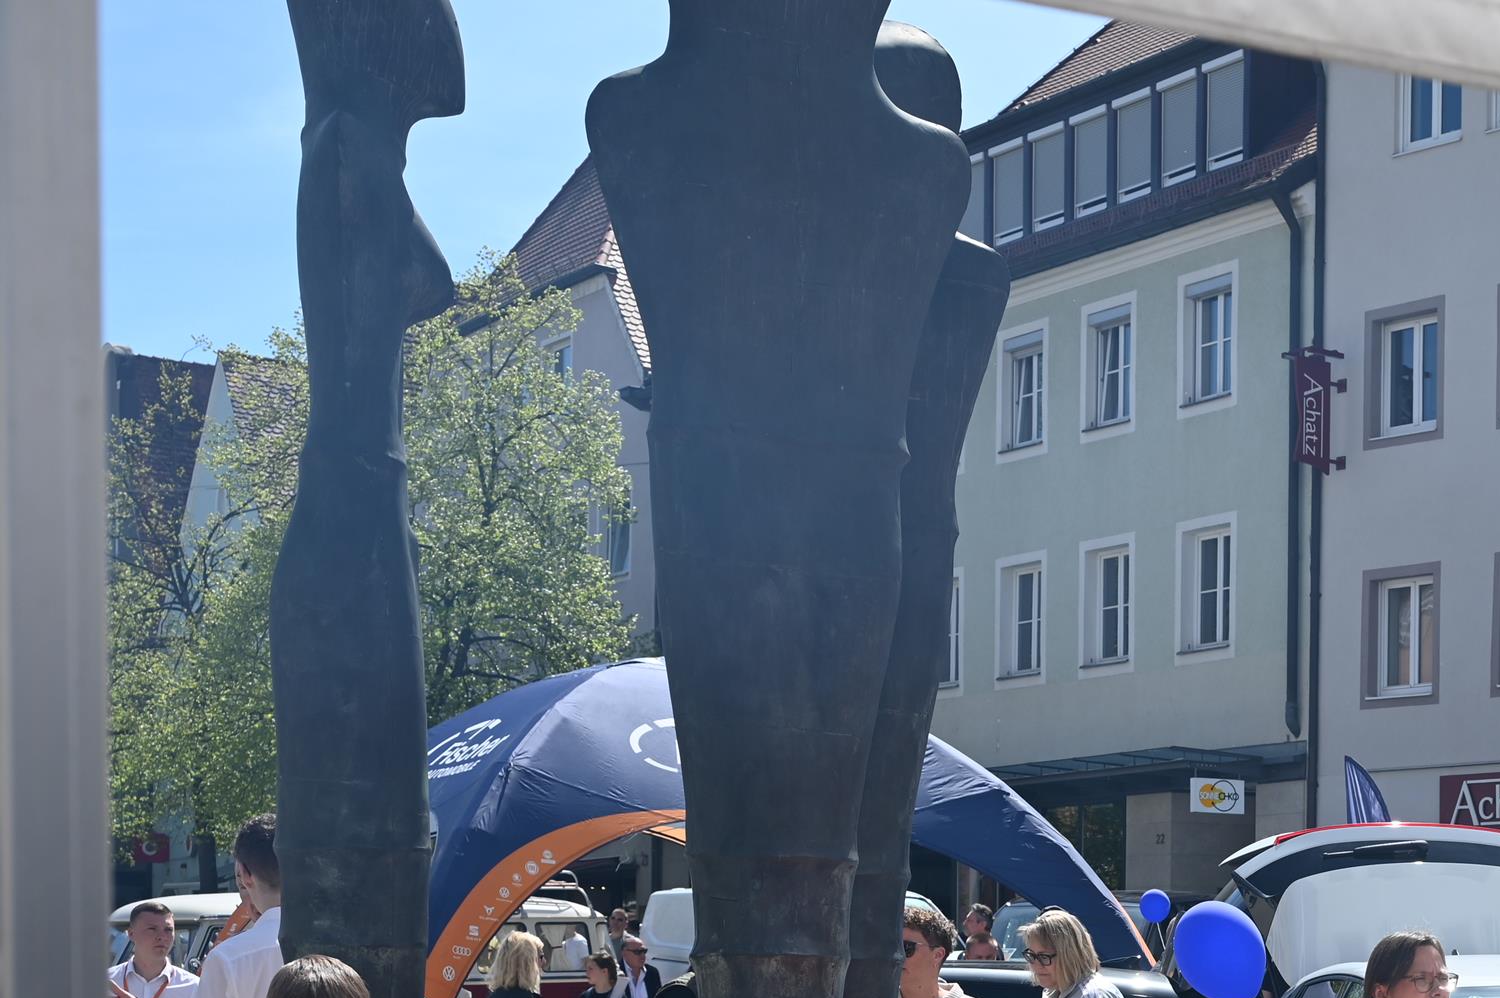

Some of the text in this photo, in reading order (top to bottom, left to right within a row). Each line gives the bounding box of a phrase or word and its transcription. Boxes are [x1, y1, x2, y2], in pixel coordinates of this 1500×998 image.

[1303, 373, 1323, 457] Achatz
[429, 735, 510, 766] Fischer
[1156, 833, 1166, 845] 22
